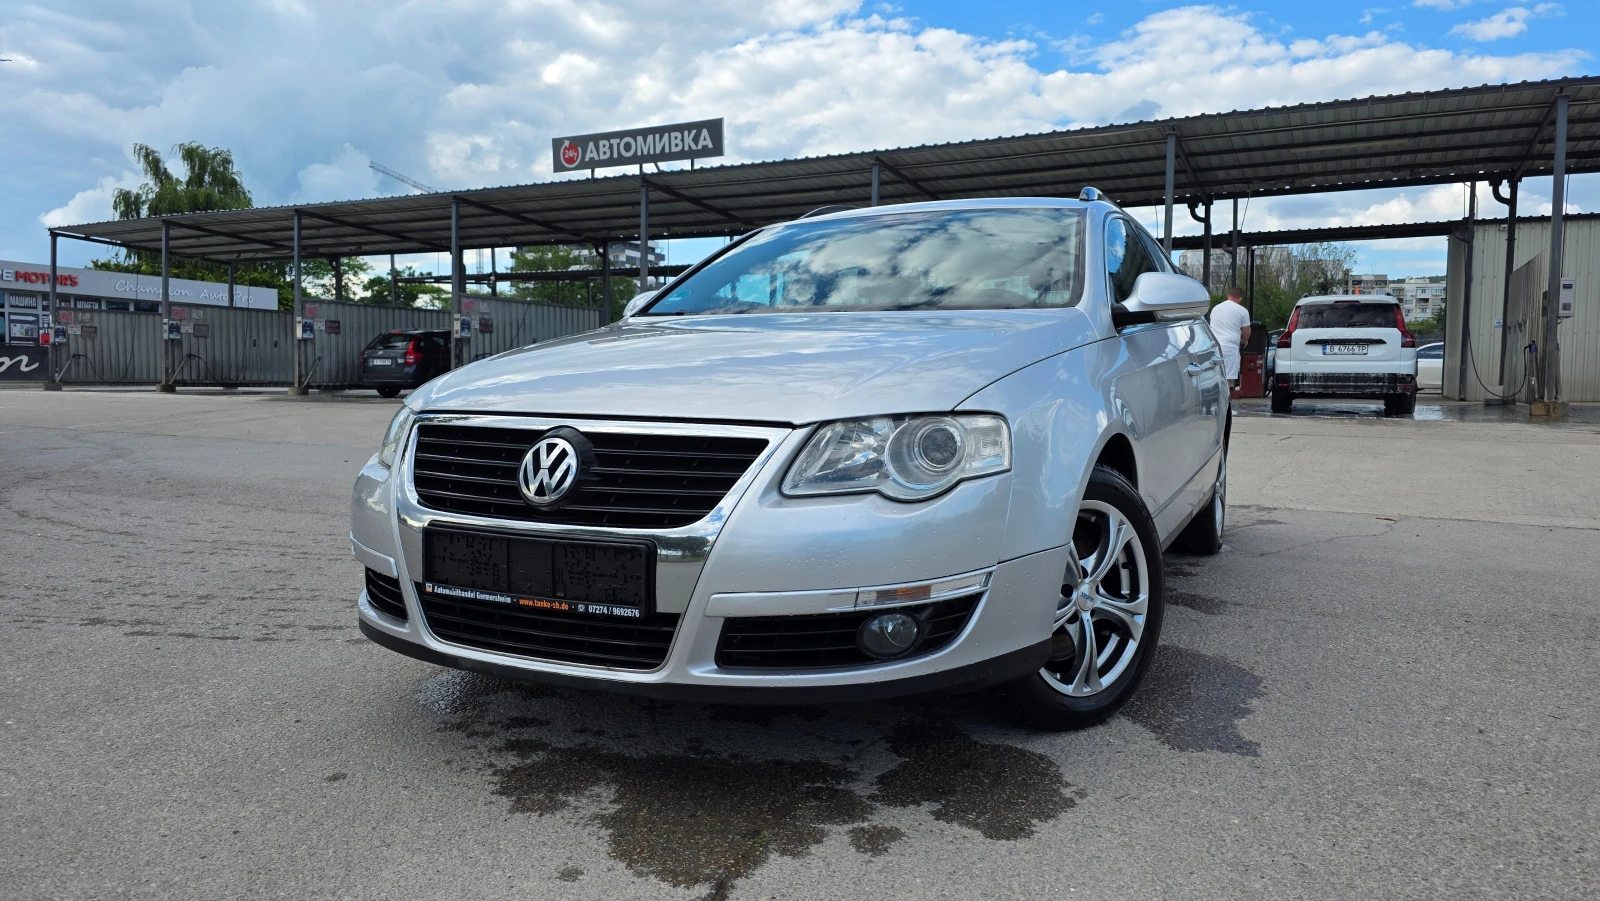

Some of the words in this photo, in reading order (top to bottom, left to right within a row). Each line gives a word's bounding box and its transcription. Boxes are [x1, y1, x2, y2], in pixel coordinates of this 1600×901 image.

[584, 128, 713, 162] АВТОМИВКА
[10, 295, 37, 307] МАШИНА
[199, 288, 229, 302] Auto
[433, 585, 476, 599] Automobilhandel
[476, 591, 512, 604] Germersheim
[519, 597, 569, 611] www.tanke-sb.de
[588, 604, 608, 615] 07274
[612, 606, 640, 618] 9692676
